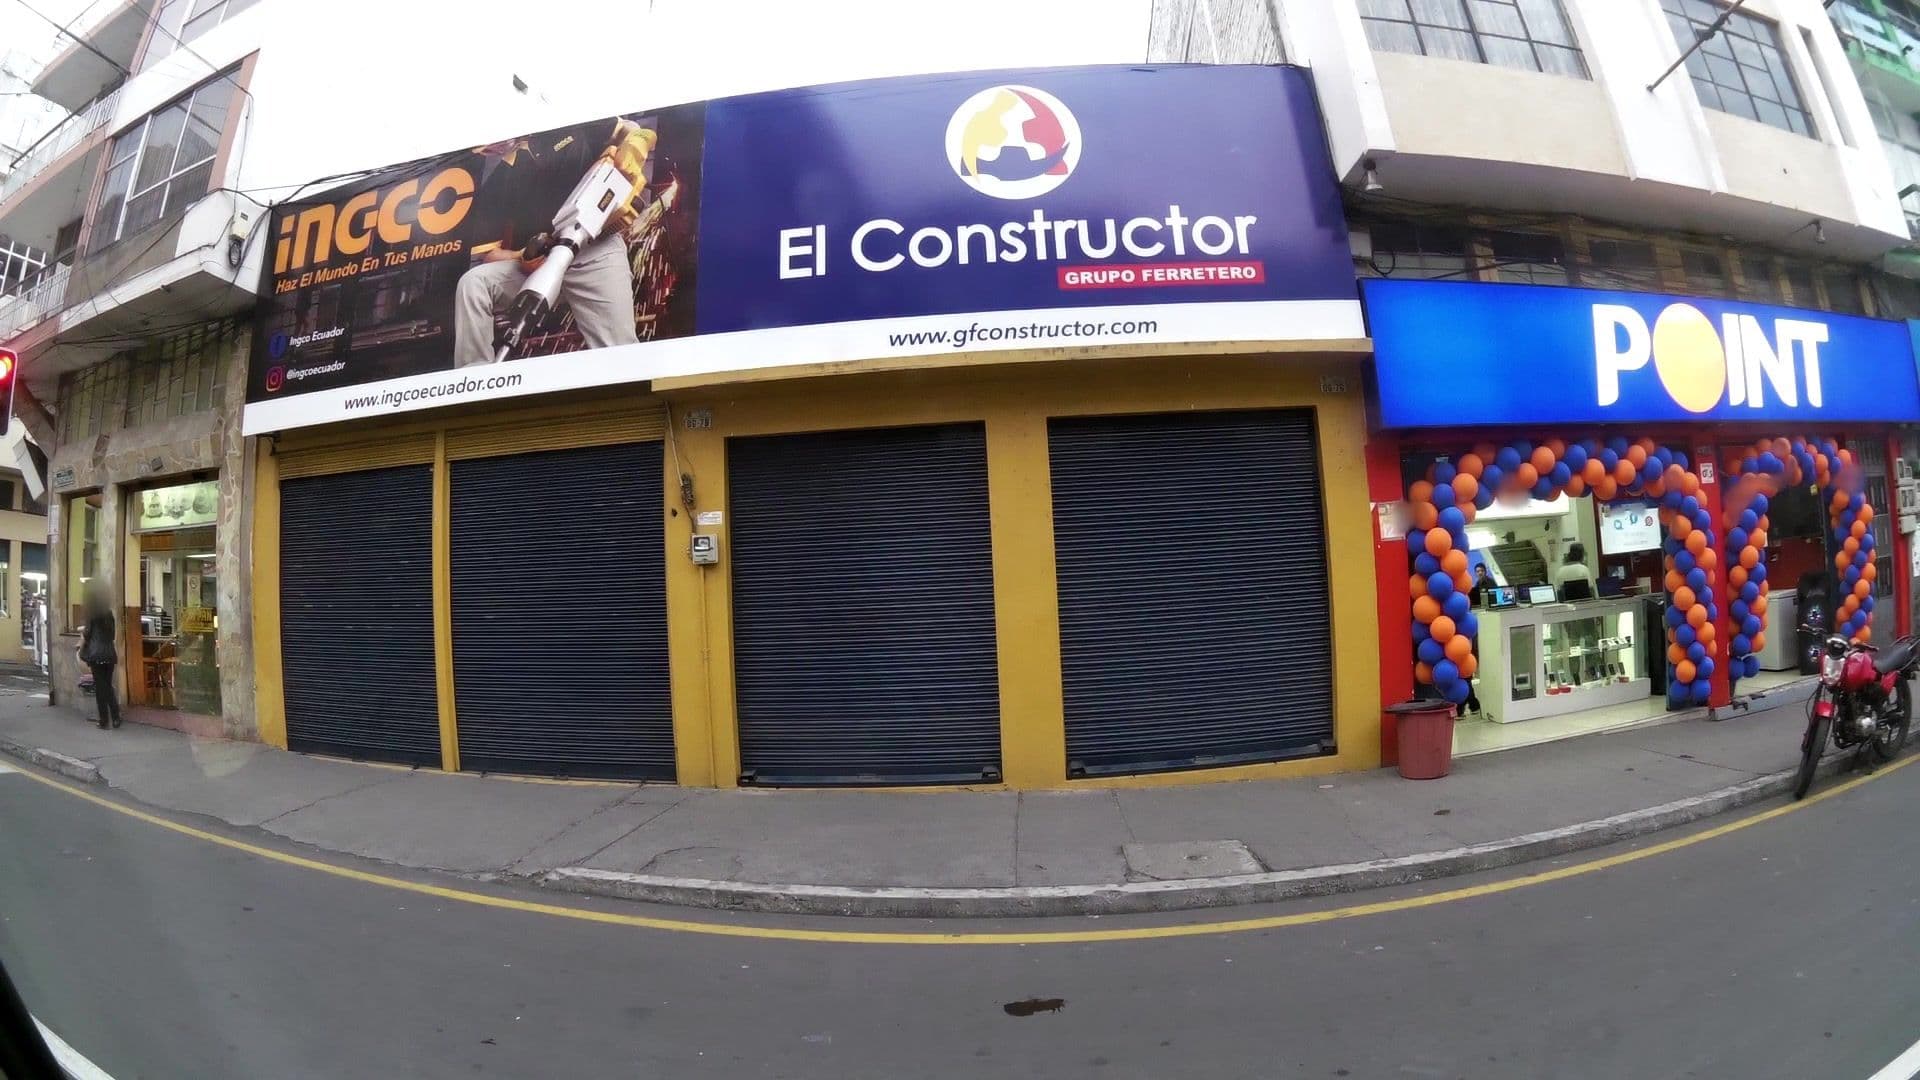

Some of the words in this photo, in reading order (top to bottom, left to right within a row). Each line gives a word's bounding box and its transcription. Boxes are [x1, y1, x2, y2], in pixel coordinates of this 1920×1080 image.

[779, 224, 826, 280] El
[850, 204, 1257, 272] Constructor
[275, 278, 297, 294] Haz
[300, 273, 312, 287] El
[314, 263, 358, 284] Mundo
[361, 257, 380, 272] En
[384, 250, 408, 266] Tus
[411, 239, 463, 260] Manos
[1063, 268, 1135, 286] GRUPO
[1140, 264, 1257, 283] FERRETERO
[289, 330, 311, 347] Ingco
[312, 326, 346, 342] Ecuador
[888, 317, 1158, 349] www.gfconstructor.com
[286, 360, 346, 381] @ingcoecuador
[1591, 302, 1829, 414] POINT
[344, 372, 523, 411] www.ingcoecuador.com
